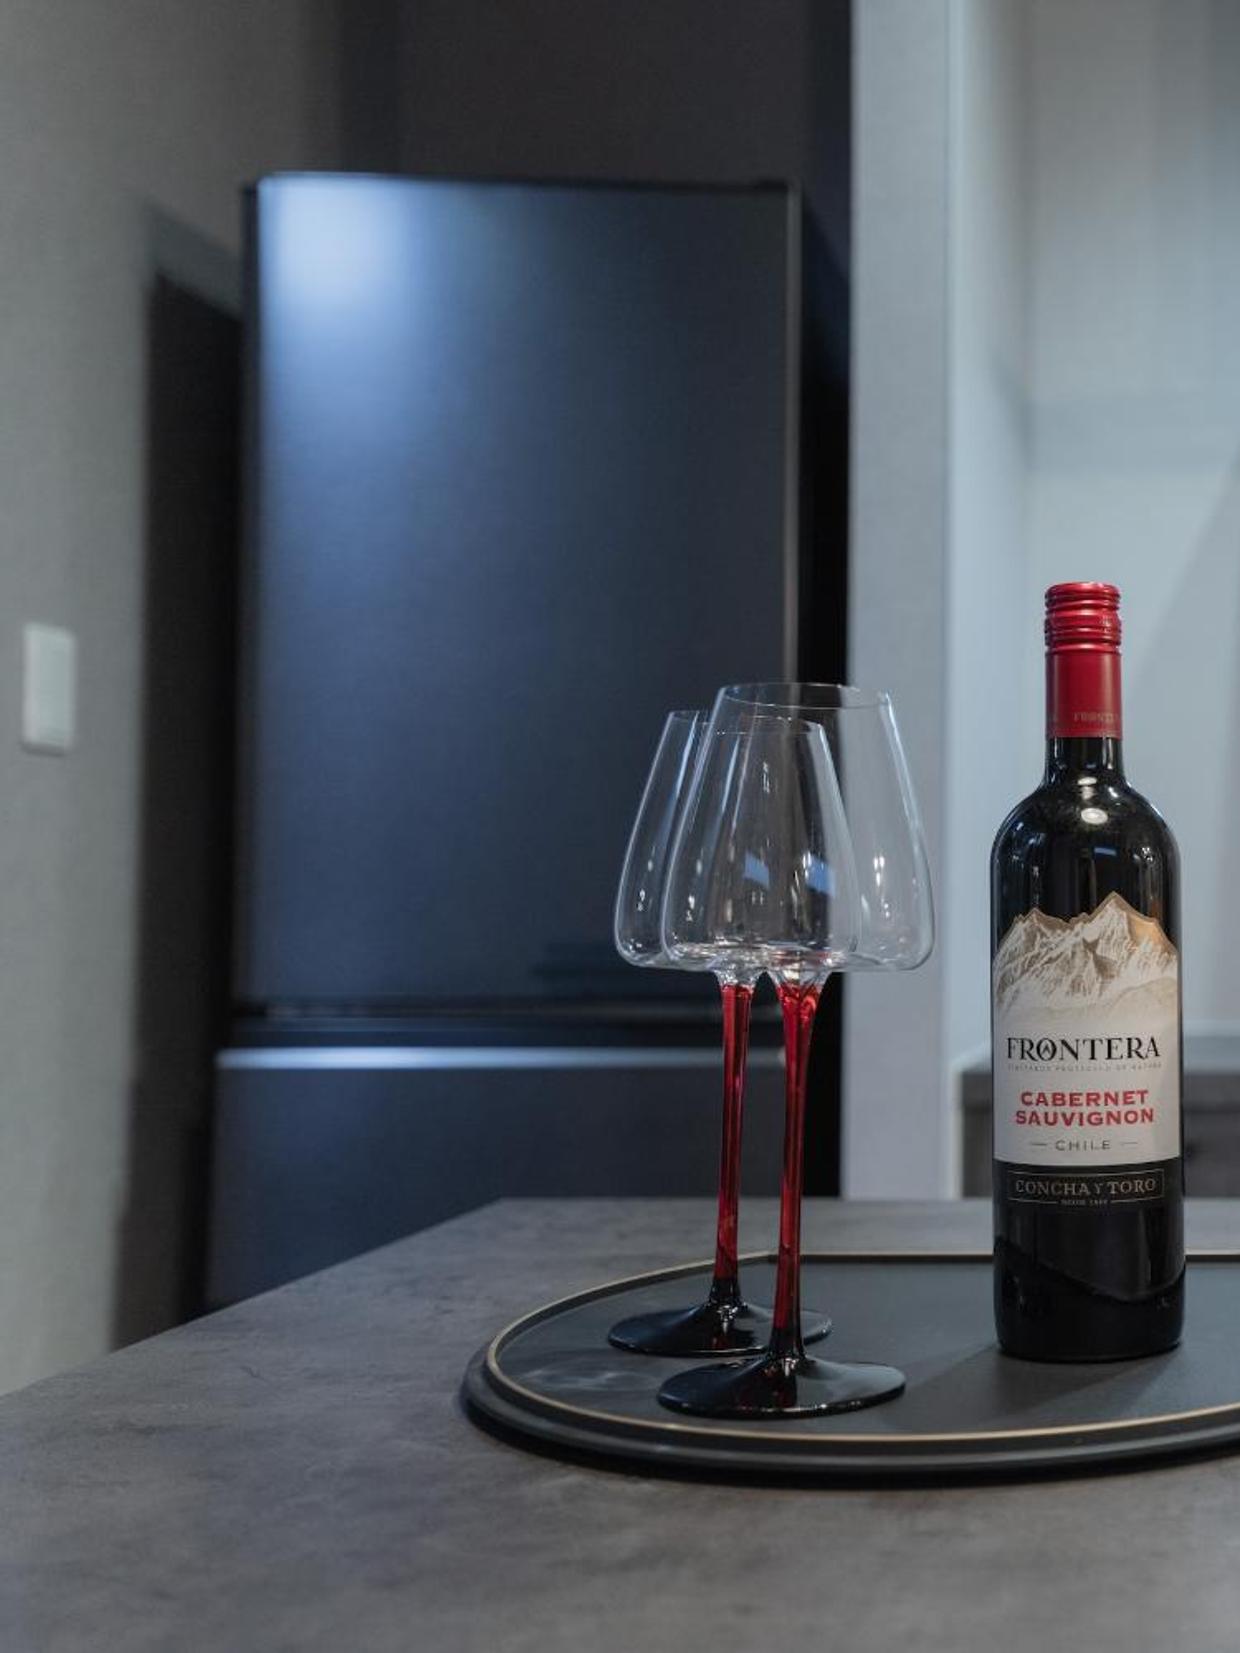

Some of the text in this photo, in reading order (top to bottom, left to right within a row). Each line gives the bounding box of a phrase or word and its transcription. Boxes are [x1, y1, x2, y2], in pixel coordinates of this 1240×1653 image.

[1007, 1037, 1161, 1061] FRONTERA
[1020, 1090, 1149, 1107] CABERNET
[1015, 1108, 1154, 1126] SAUVIGNON
[1055, 1140, 1111, 1151] CHILE
[1015, 1178, 1156, 1196] CONCHA Y TORO
